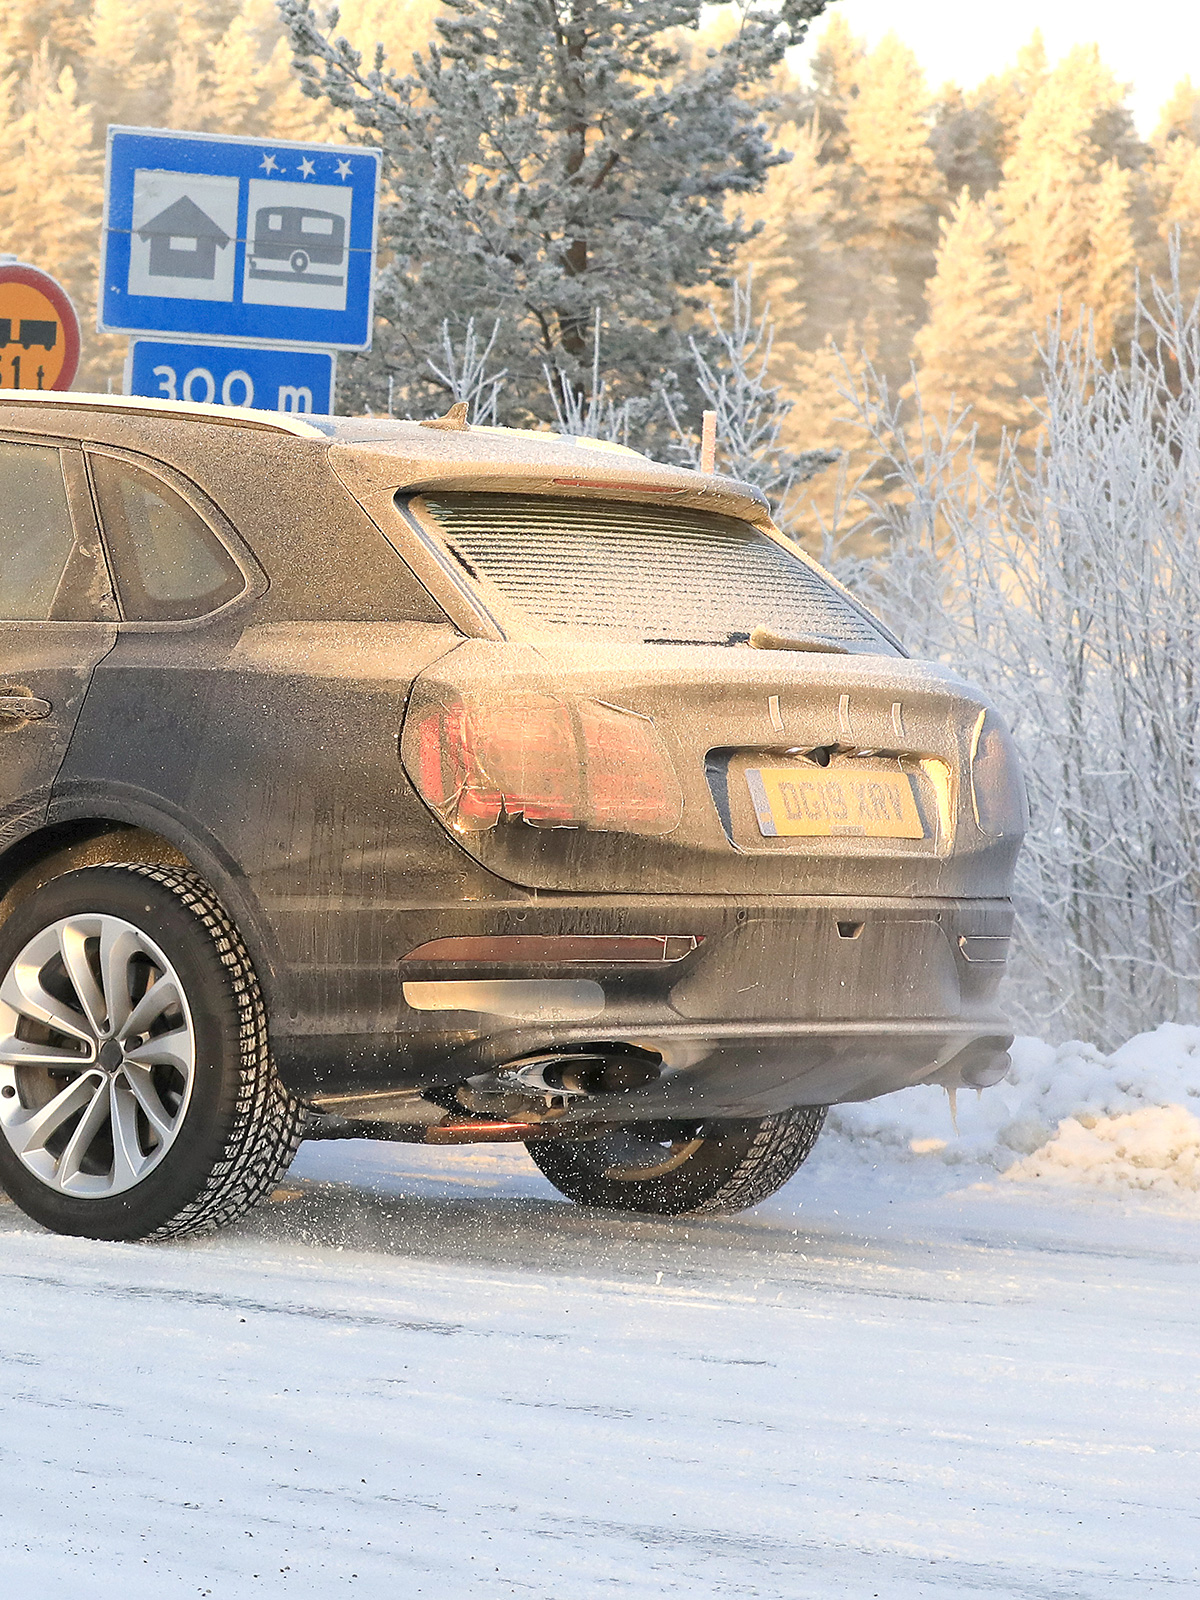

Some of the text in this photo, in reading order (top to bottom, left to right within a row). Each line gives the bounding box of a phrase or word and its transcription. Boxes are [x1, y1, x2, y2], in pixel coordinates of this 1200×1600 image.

[36, 365, 45, 390] t
[152, 364, 313, 415] 300 m
